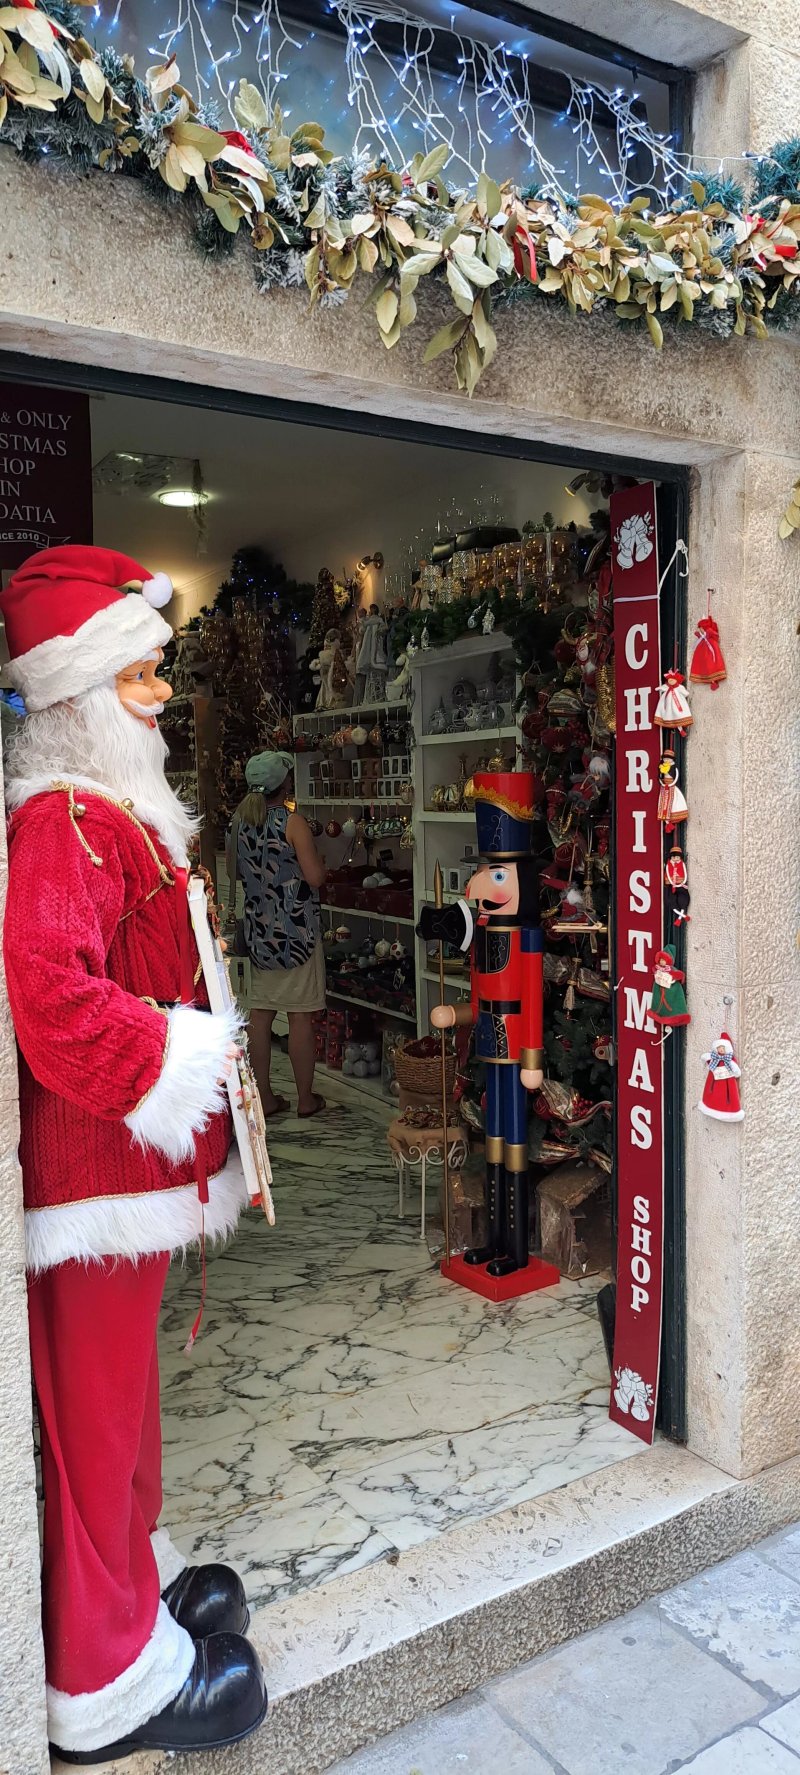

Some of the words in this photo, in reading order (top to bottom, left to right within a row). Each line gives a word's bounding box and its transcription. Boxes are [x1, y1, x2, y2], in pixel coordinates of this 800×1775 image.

[0, 411, 11, 423] &
[17, 409, 72, 431] ONLY
[0, 480, 20, 497] IN
[17, 532, 39, 541] 2010
[624, 622, 657, 1150] CHRISTMAS
[630, 1195, 652, 1313] SHOP
